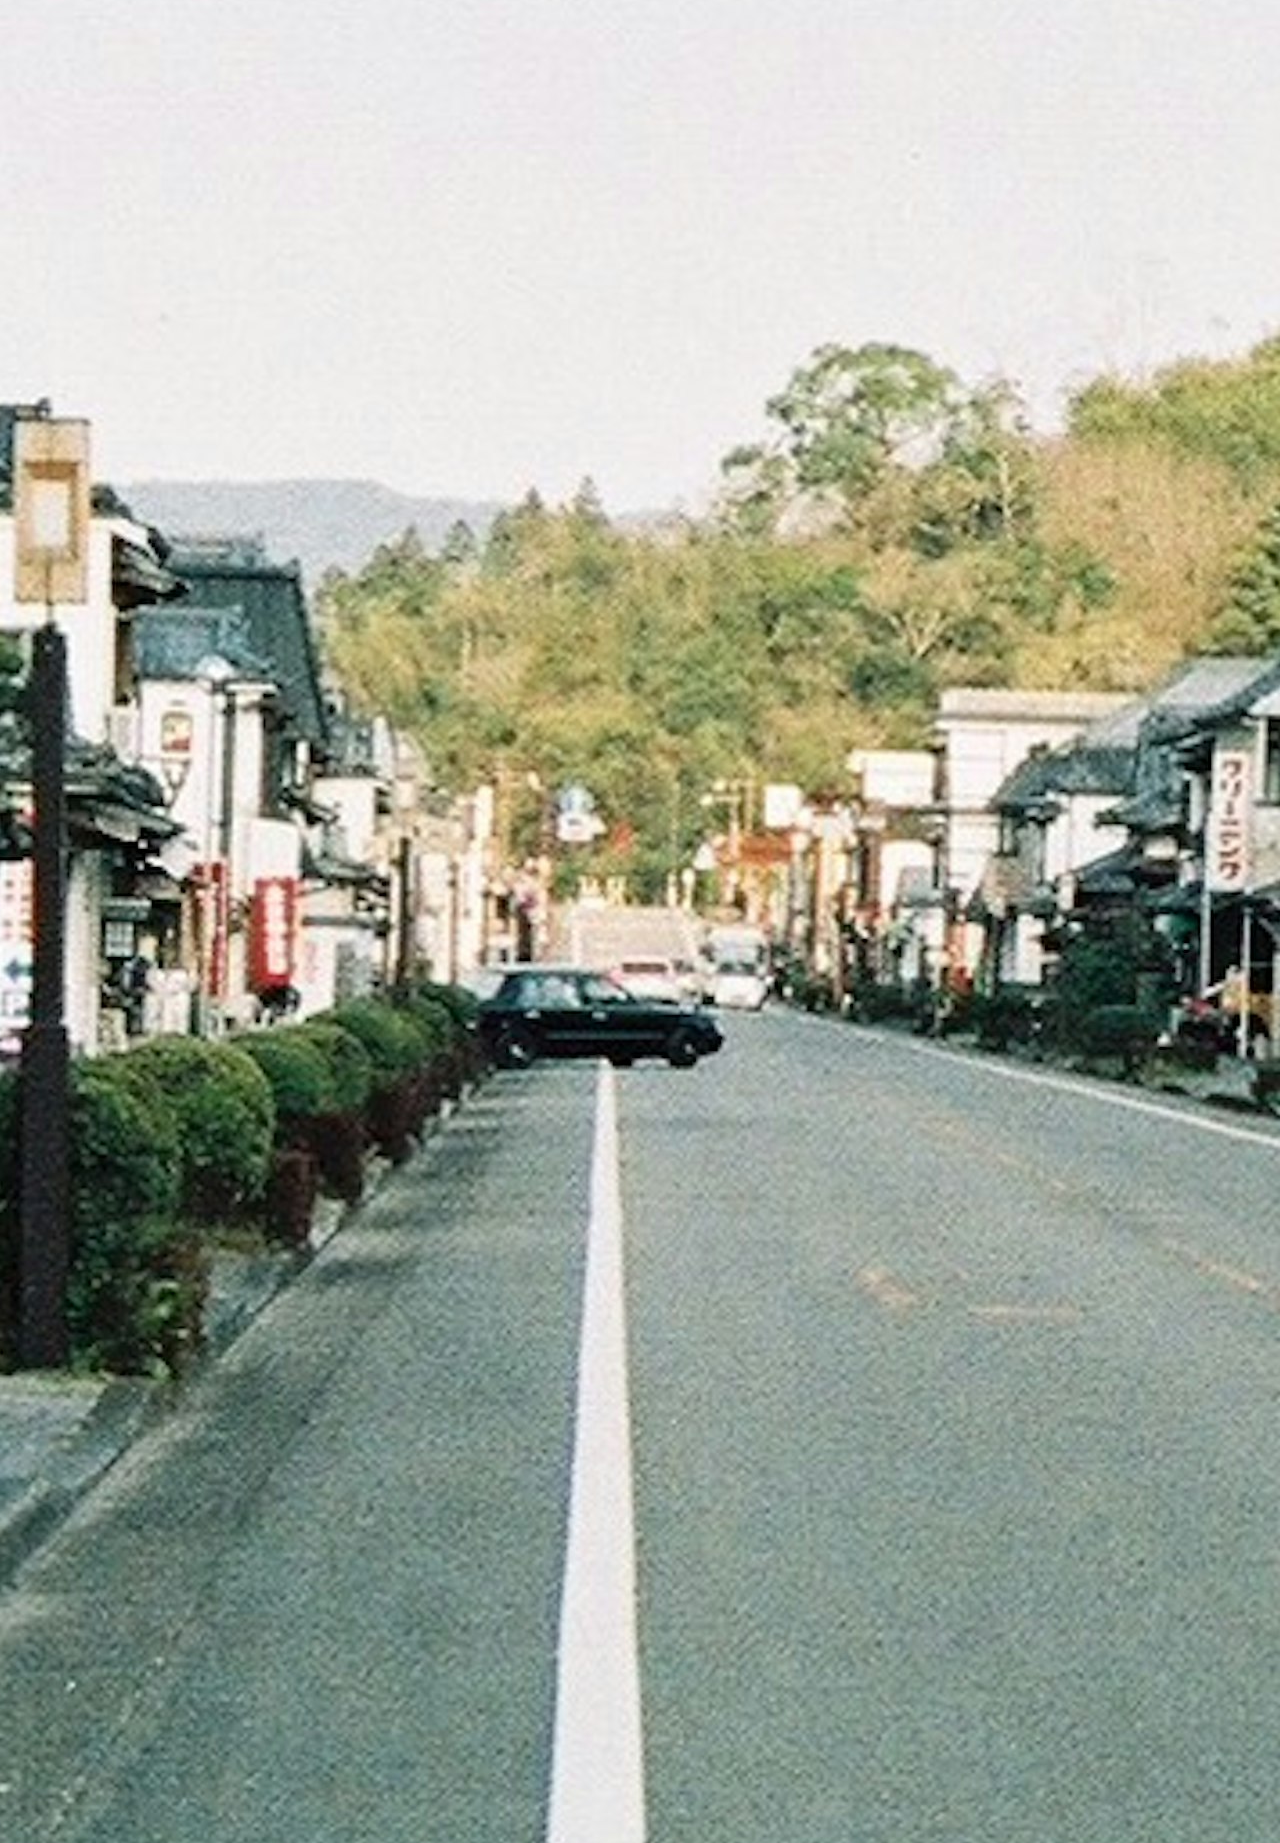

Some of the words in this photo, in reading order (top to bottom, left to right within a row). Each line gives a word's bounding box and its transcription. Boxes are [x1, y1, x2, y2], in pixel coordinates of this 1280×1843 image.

[1218, 759, 1242, 880] クリーニング
